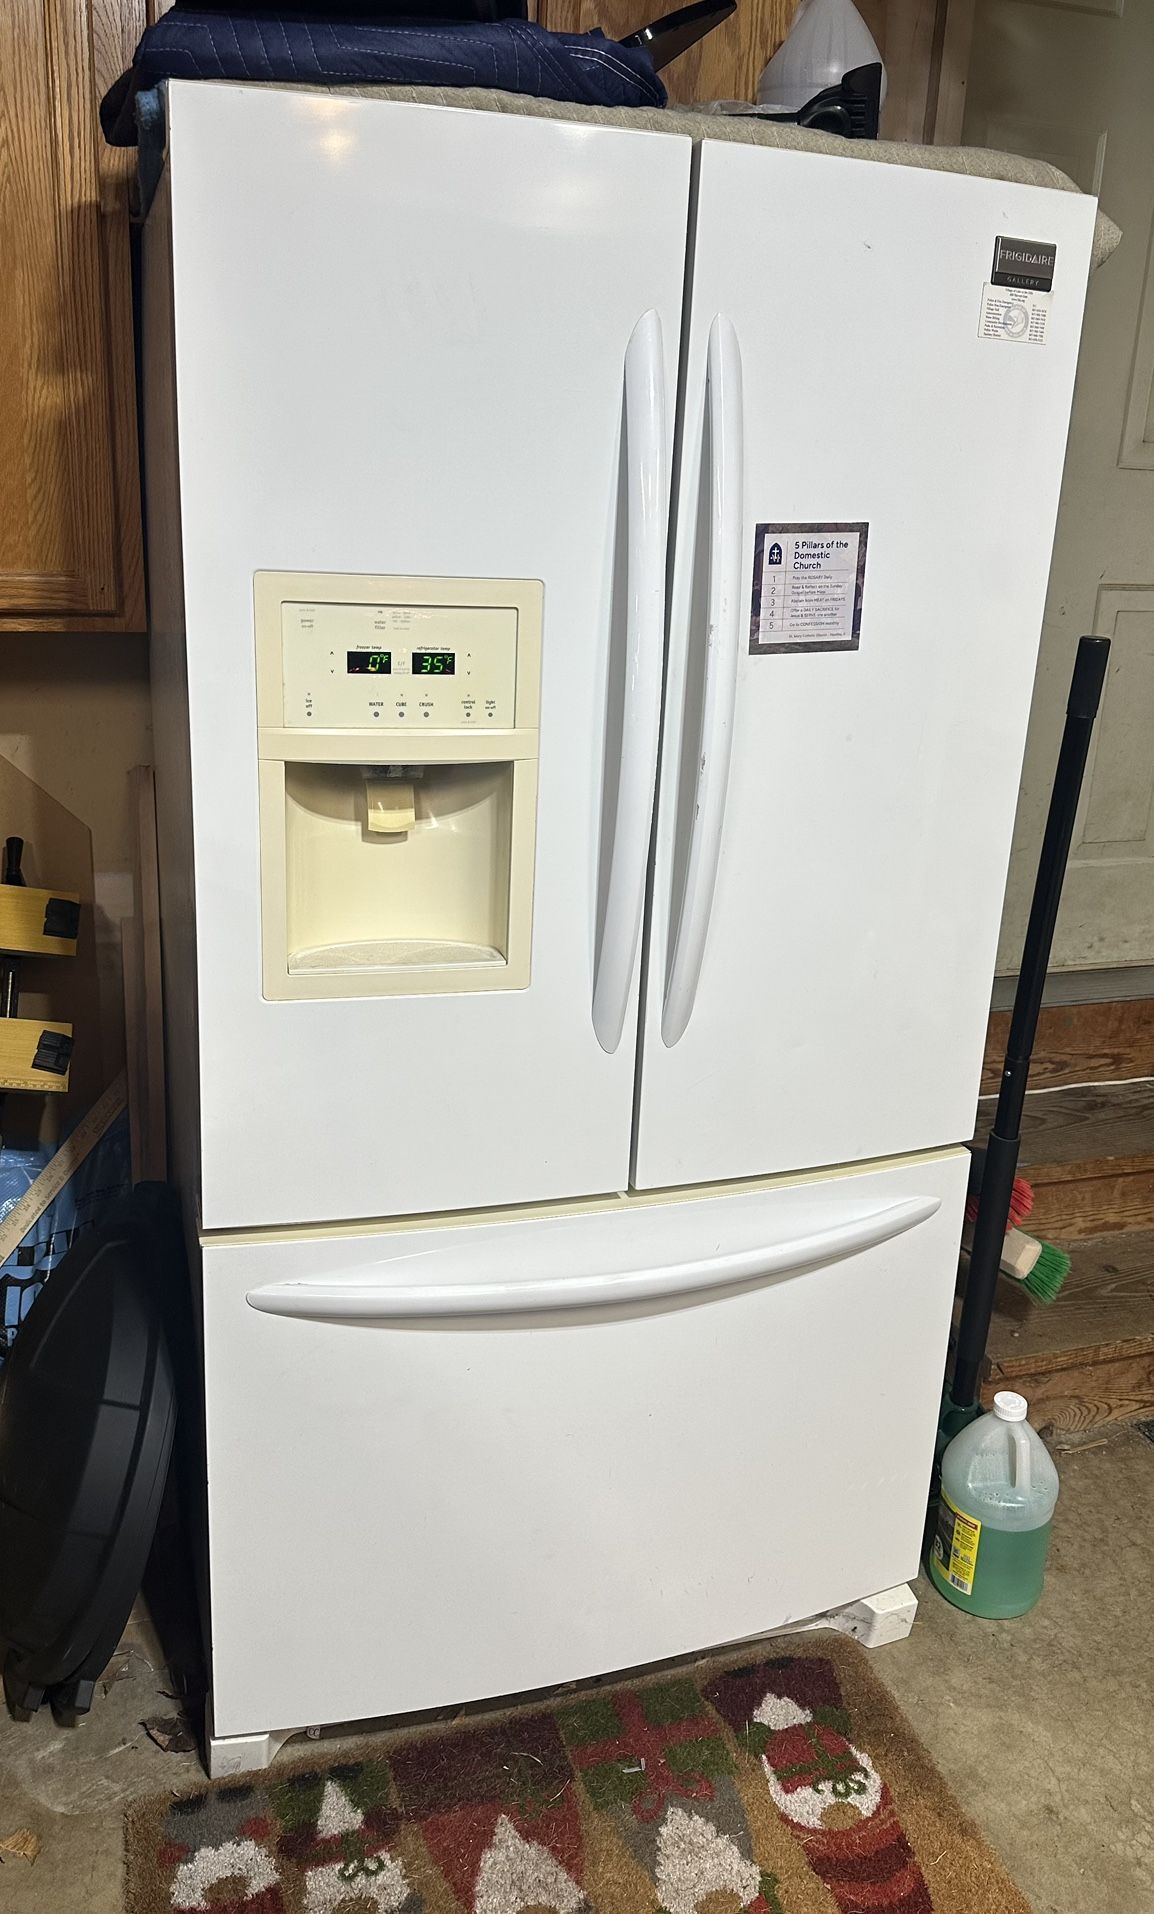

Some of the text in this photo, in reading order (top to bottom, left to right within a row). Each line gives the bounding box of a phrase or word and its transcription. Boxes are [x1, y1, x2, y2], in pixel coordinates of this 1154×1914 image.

[1000, 250, 1054, 266] FRIGIDAIRE
[1007, 276, 1040, 286] GALLERY
[802, 541, 824, 549] Pillars
[826, 541, 834, 549] of
[794, 551, 830, 559] Domestic
[421, 655, 452, 673] 35°F
